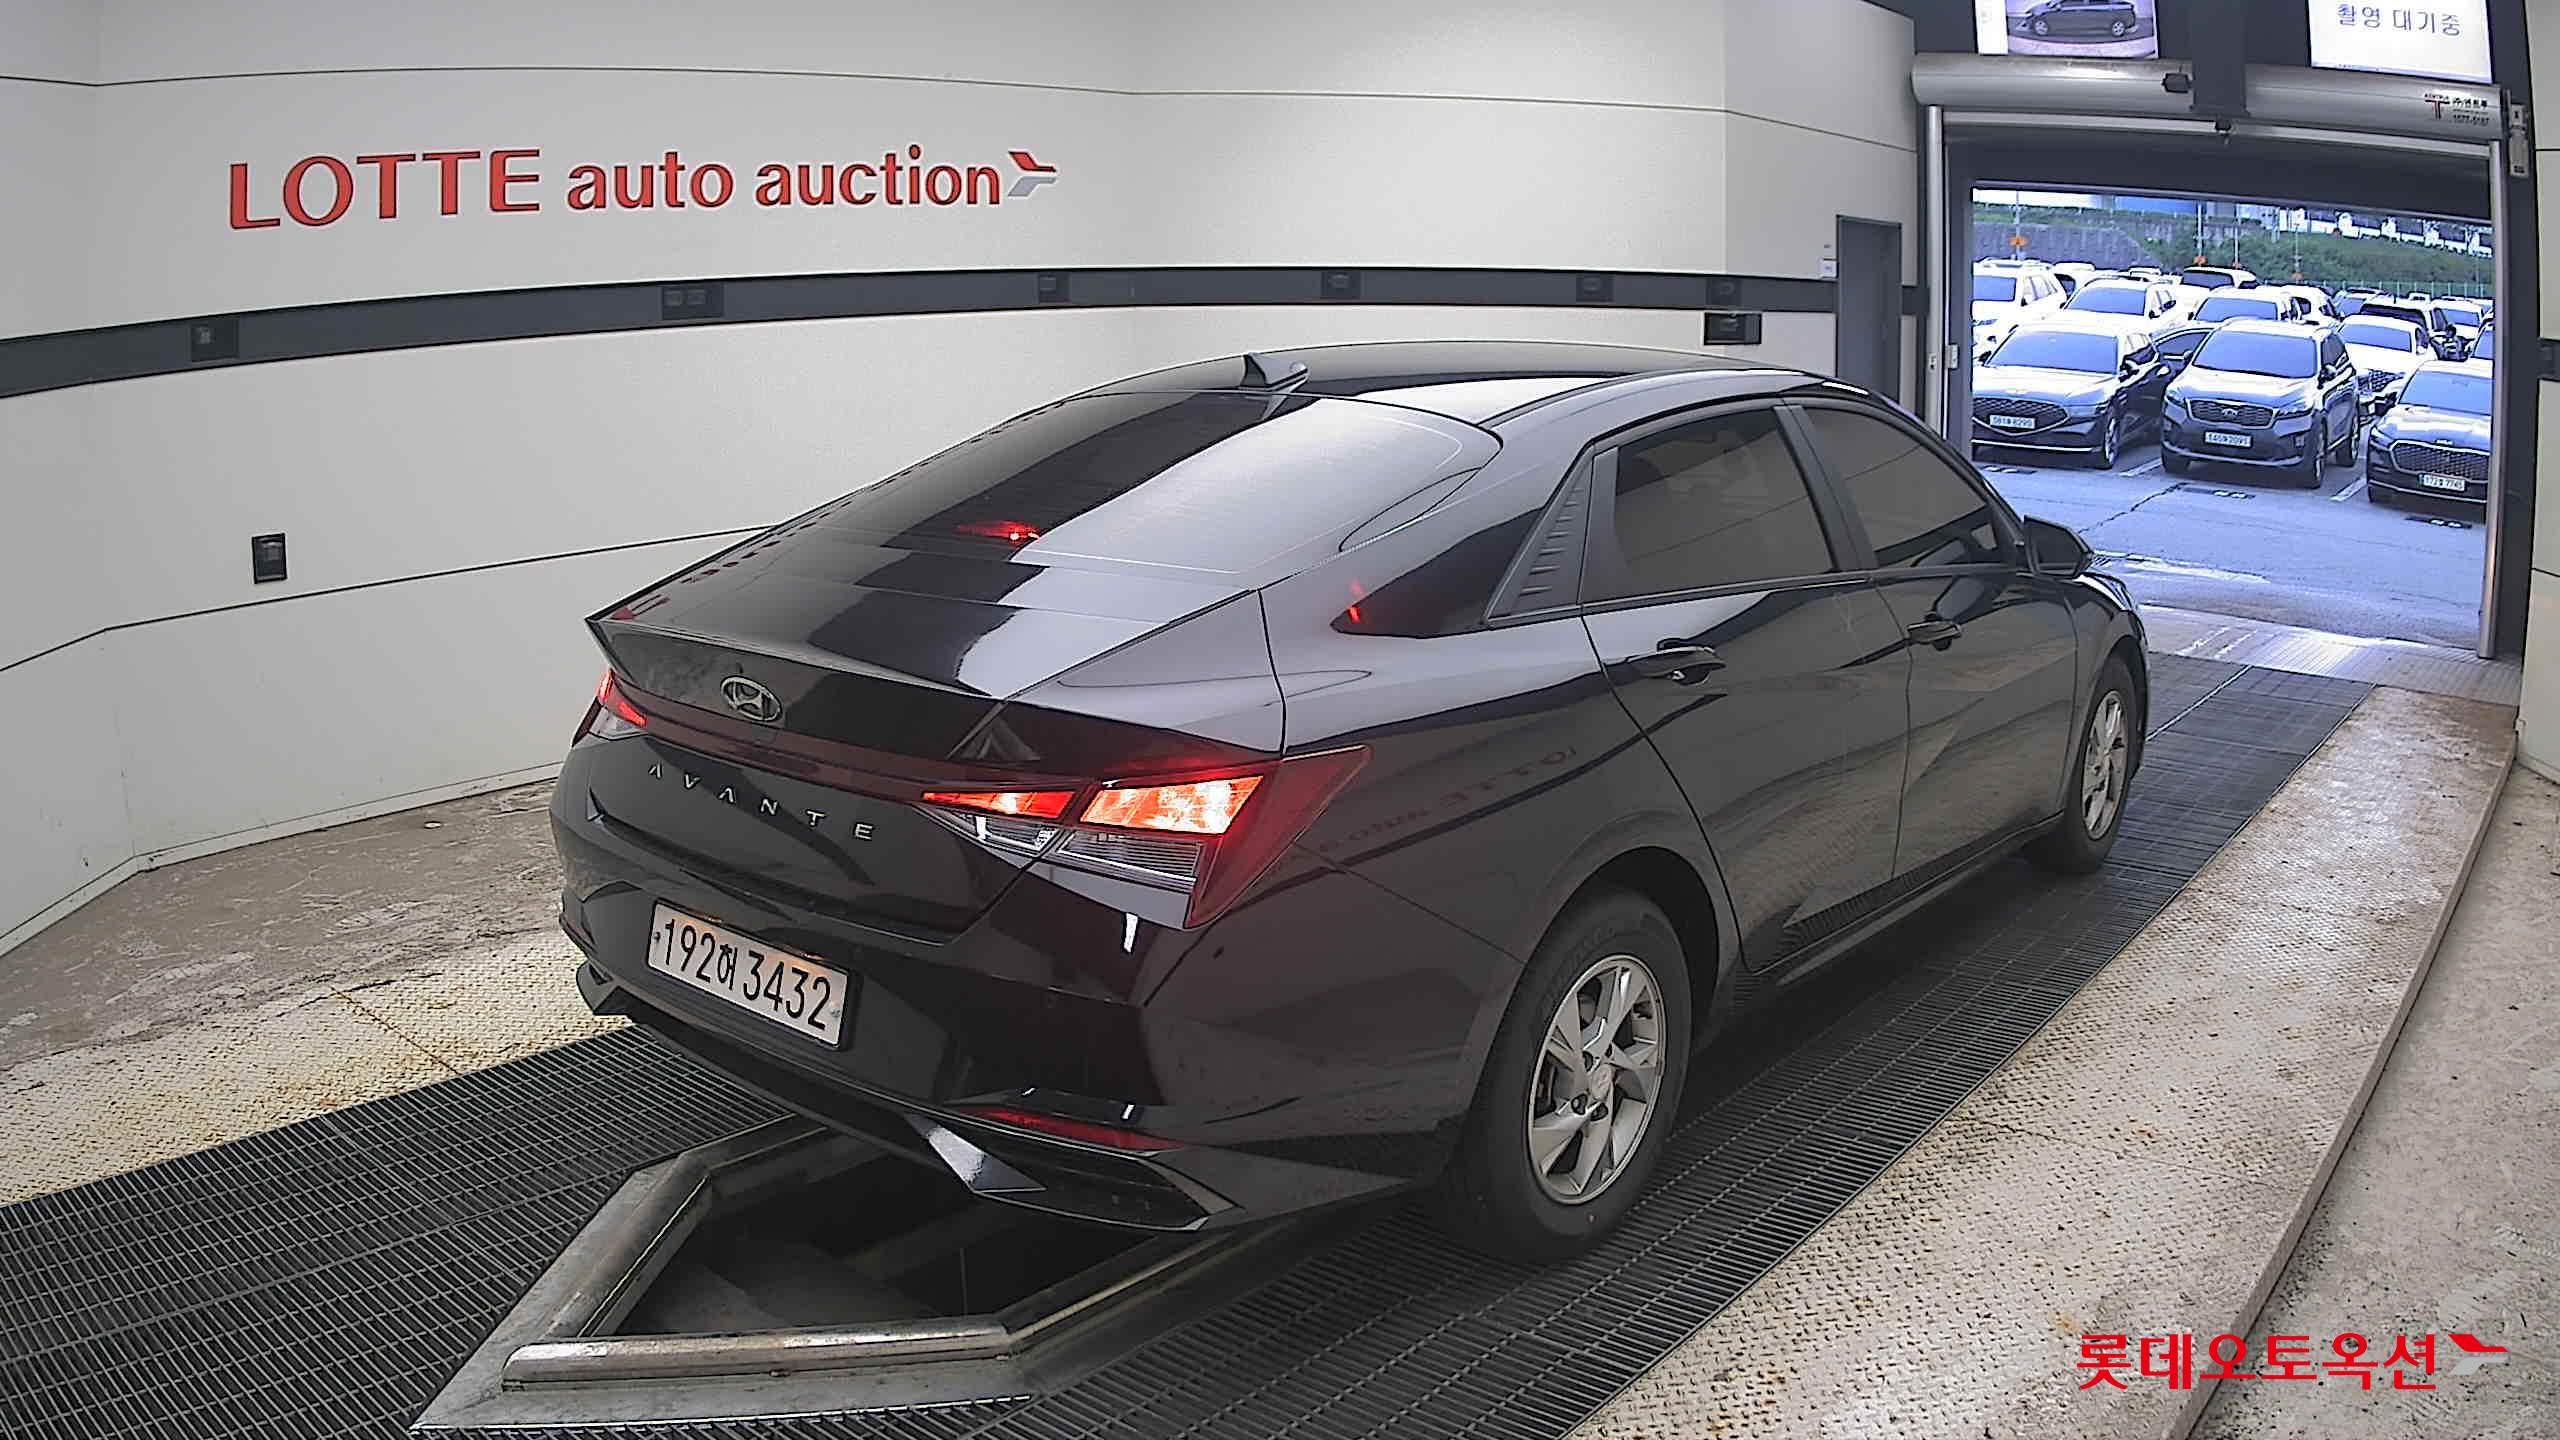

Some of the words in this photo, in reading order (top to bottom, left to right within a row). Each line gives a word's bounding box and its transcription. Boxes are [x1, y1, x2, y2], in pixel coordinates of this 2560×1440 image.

[2338, 5, 2381, 29] 촬영
[2392, 9, 2461, 37] 대기중
[229, 147, 540, 230] LOTTE
[567, 151, 735, 210] auto
[754, 145, 1002, 207] auction
[648, 762, 875, 840] AVANTE
[664, 918, 738, 991] 192허
[743, 950, 831, 1031] 3432
